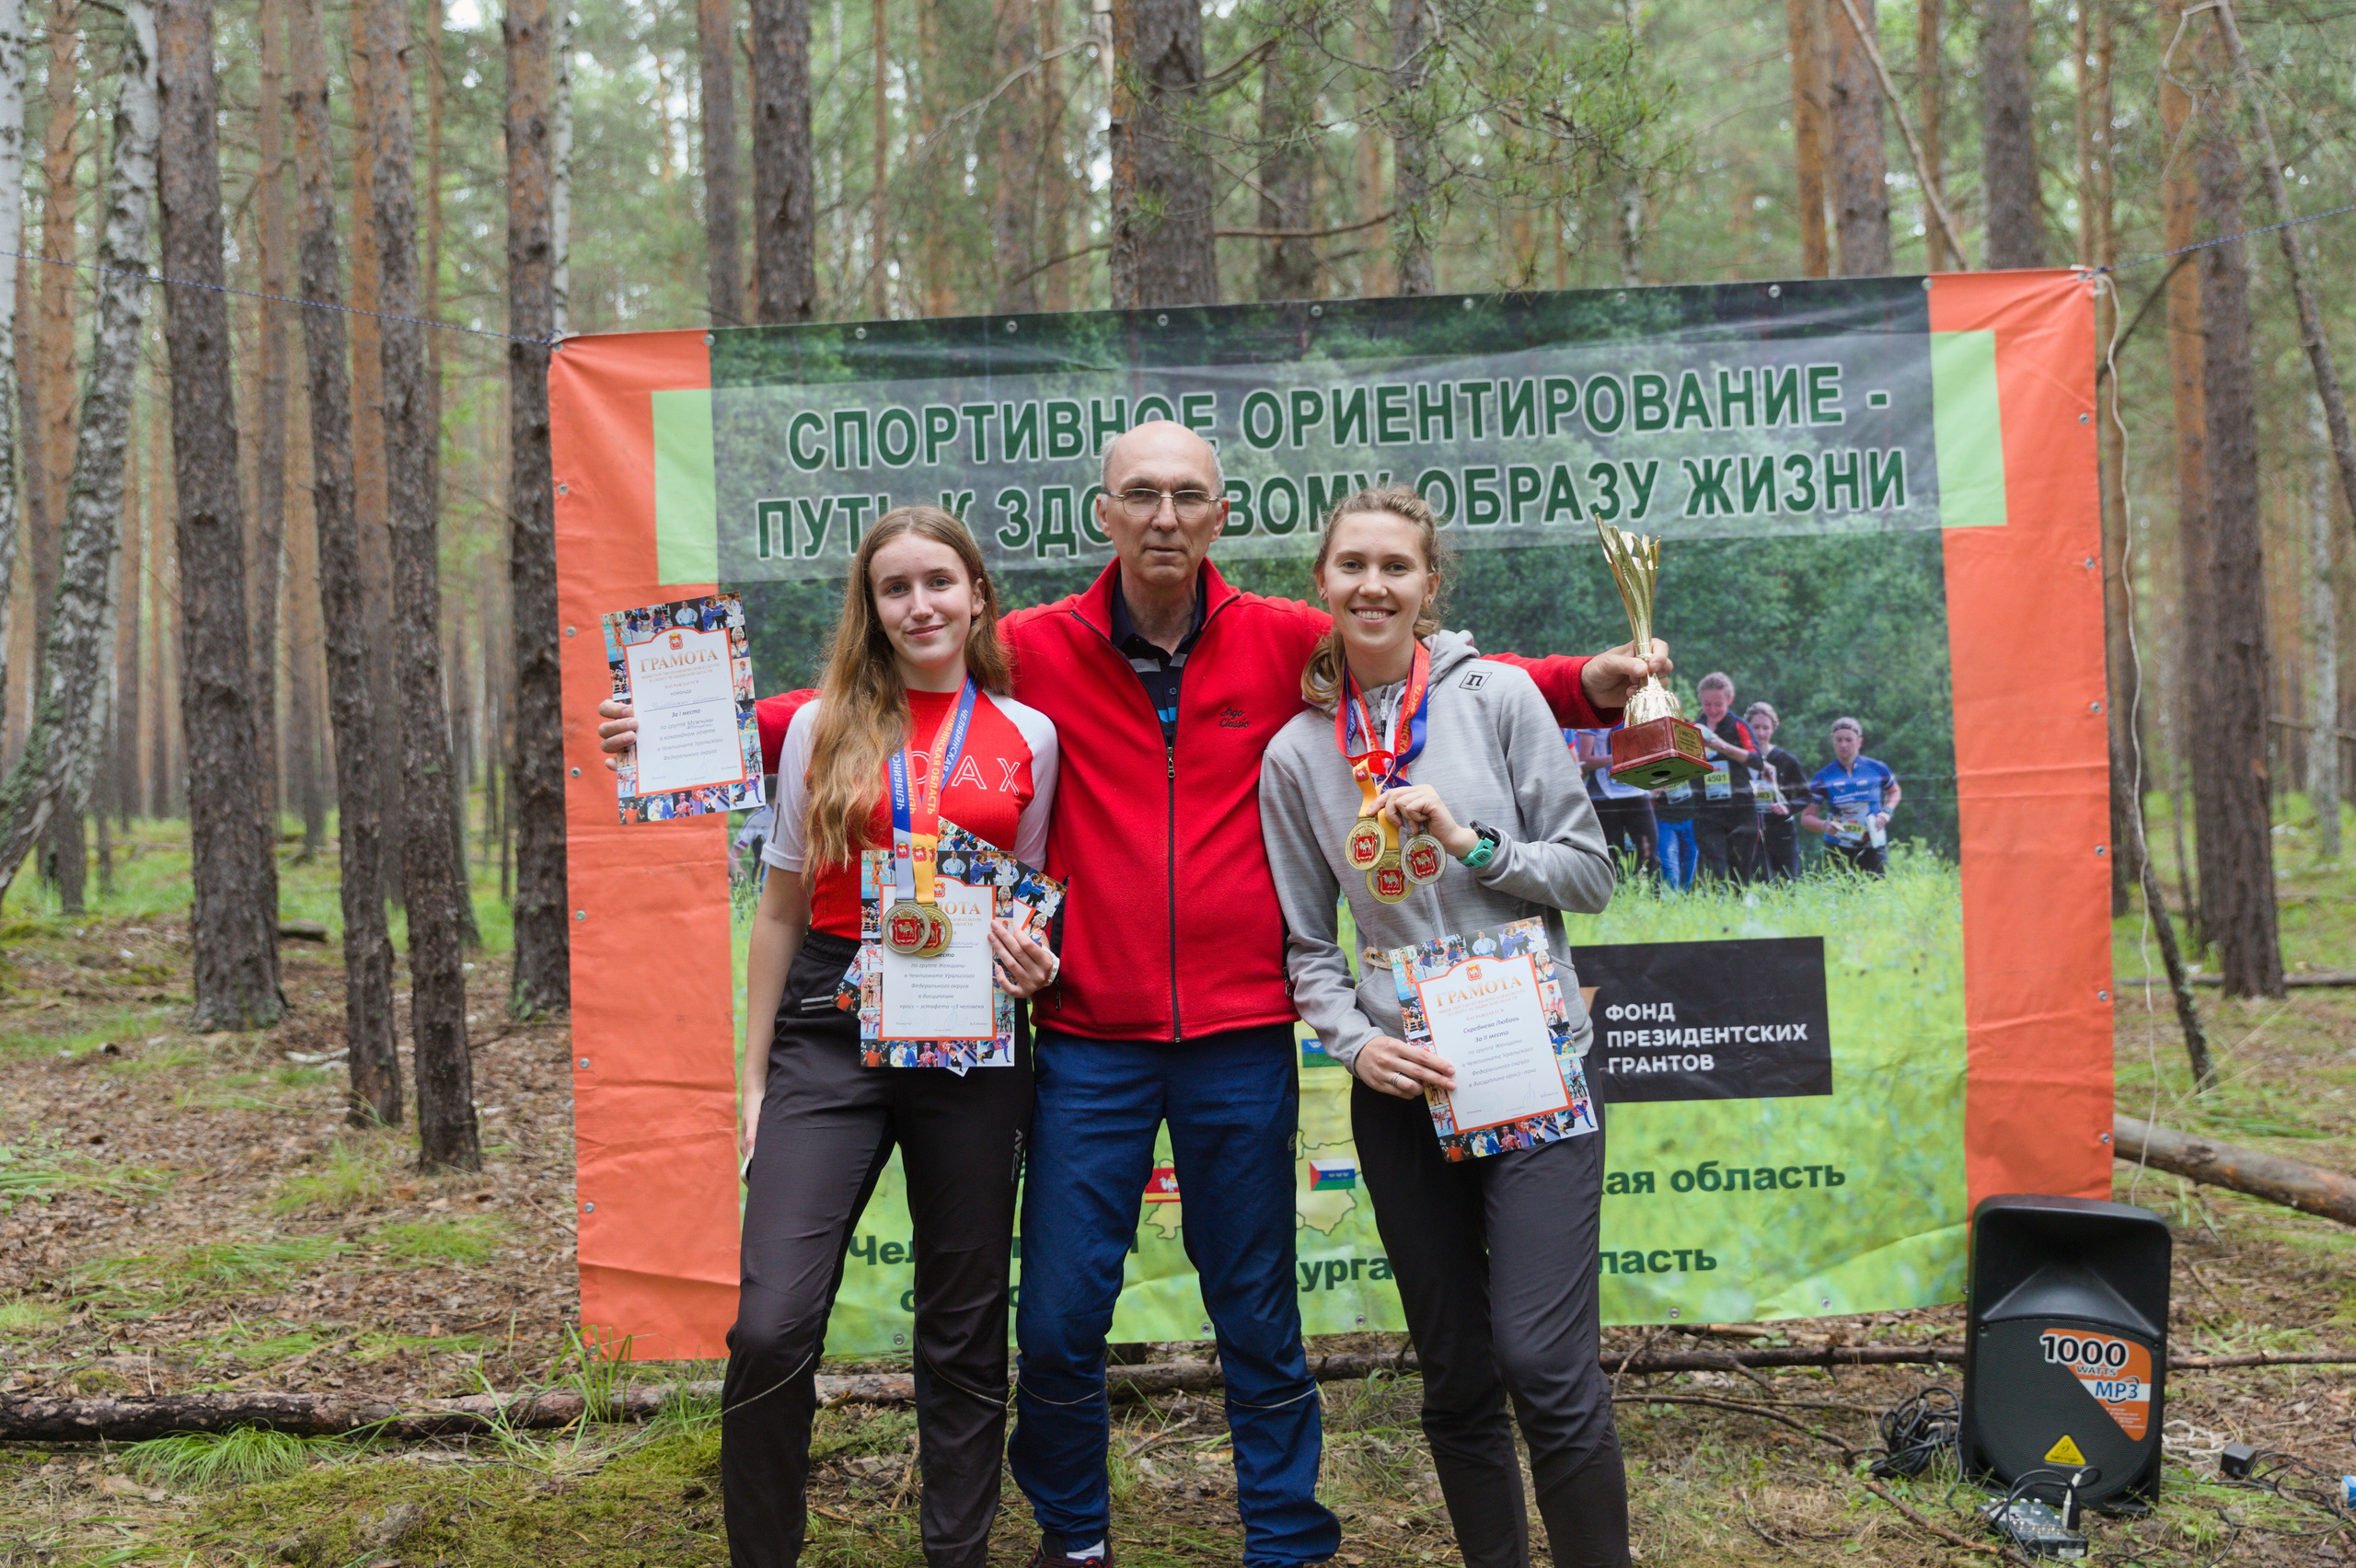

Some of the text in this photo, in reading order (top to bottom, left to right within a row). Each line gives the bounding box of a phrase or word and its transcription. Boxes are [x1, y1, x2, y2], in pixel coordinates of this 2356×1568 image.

[1242, 364, 1843, 450] ОРИЕНТИРОВАНИЕ
[1415, 460, 1658, 526] ОБРАЗУ
[1683, 449, 1907, 517] ЖИЗНИ
[640, 648, 719, 673] ГРАМОТА
[1219, 718, 1252, 728] Classic
[661, 742, 693, 750] Чемпионате
[694, 737, 722, 745] Уральского
[663, 752, 699, 760] Федерального
[927, 767, 941, 814] ОБЛАСТЬ
[1436, 975, 1522, 1007] ГРАМОТА
[1496, 1017, 1519, 1025] Любовь
[1605, 1002, 1676, 1021] ФОНД
[1495, 1039, 1522, 1048] Женщины
[1607, 1023, 1807, 1048] ПРЕЗИДЕНТСКИХ
[1466, 1055, 1501, 1066] Чемпионате
[1502, 1046, 1532, 1057] Уральского
[1608, 1054, 1715, 1075] ГРАНТОВ
[1471, 1058, 1530, 1075] Федерального округа
[1472, 1075, 1505, 1086] дисциплине
[1669, 1160, 1846, 1193] область
[2040, 1333, 2130, 1369] 1000
[2076, 1365, 2119, 1377] WATTS
[2095, 1381, 2139, 1399] MP3
